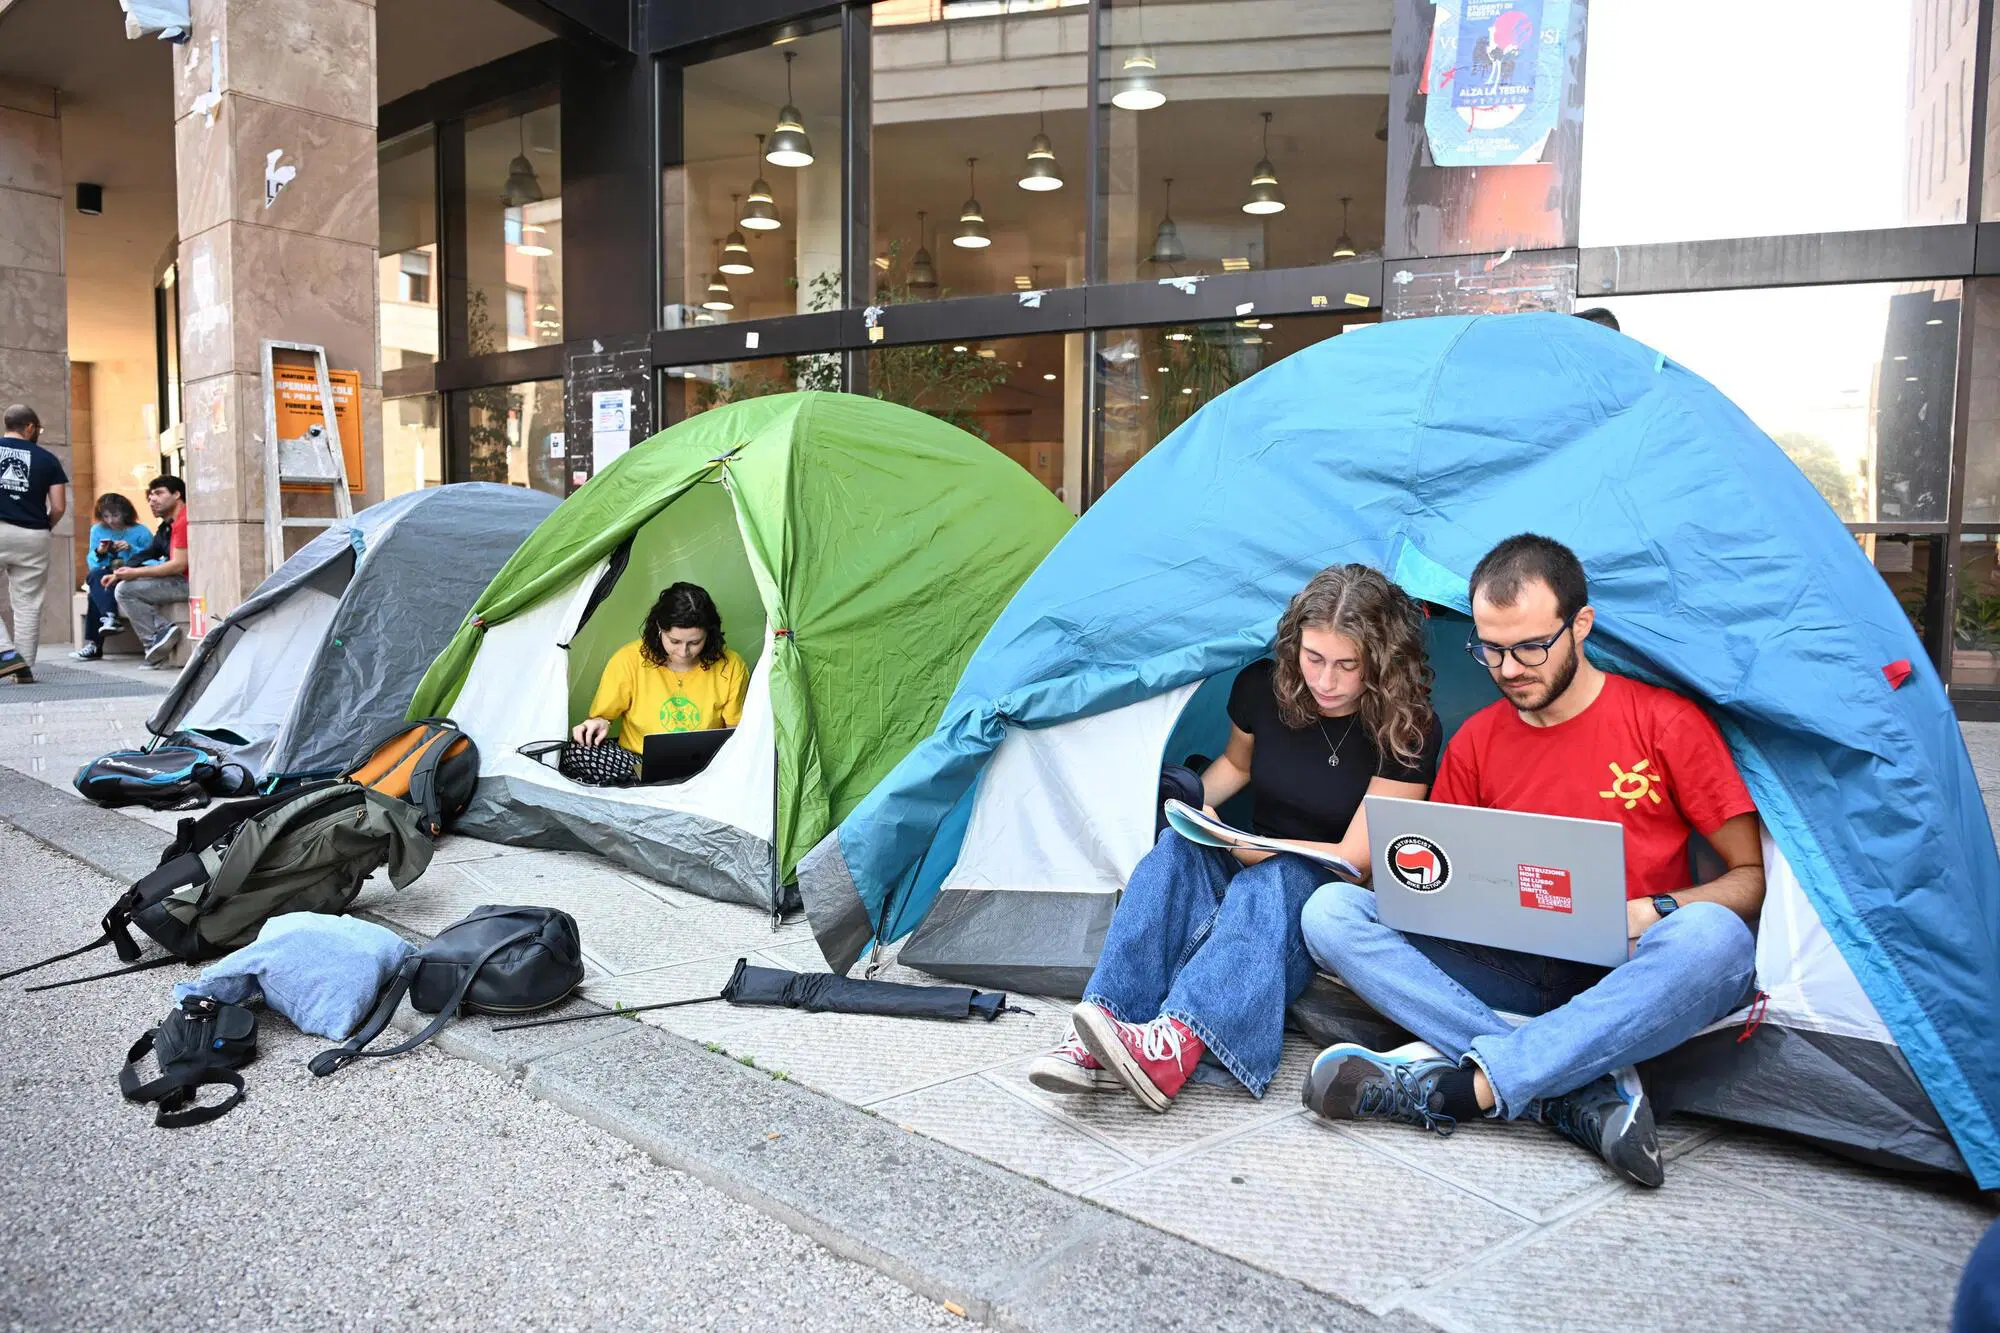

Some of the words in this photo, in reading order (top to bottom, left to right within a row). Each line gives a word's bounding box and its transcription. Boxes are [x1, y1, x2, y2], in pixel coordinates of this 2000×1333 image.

[1459, 87, 1483, 97] ALZA
[1485, 87, 1497, 96] LA
[1394, 839, 1433, 850] ANTIFASCIST
[1519, 865, 1567, 877] L'ISTRUZIONE
[1406, 880, 1420, 889] BIKE
[1422, 879, 1442, 890] ACTION
[1532, 878, 1554, 886] LUSSO
